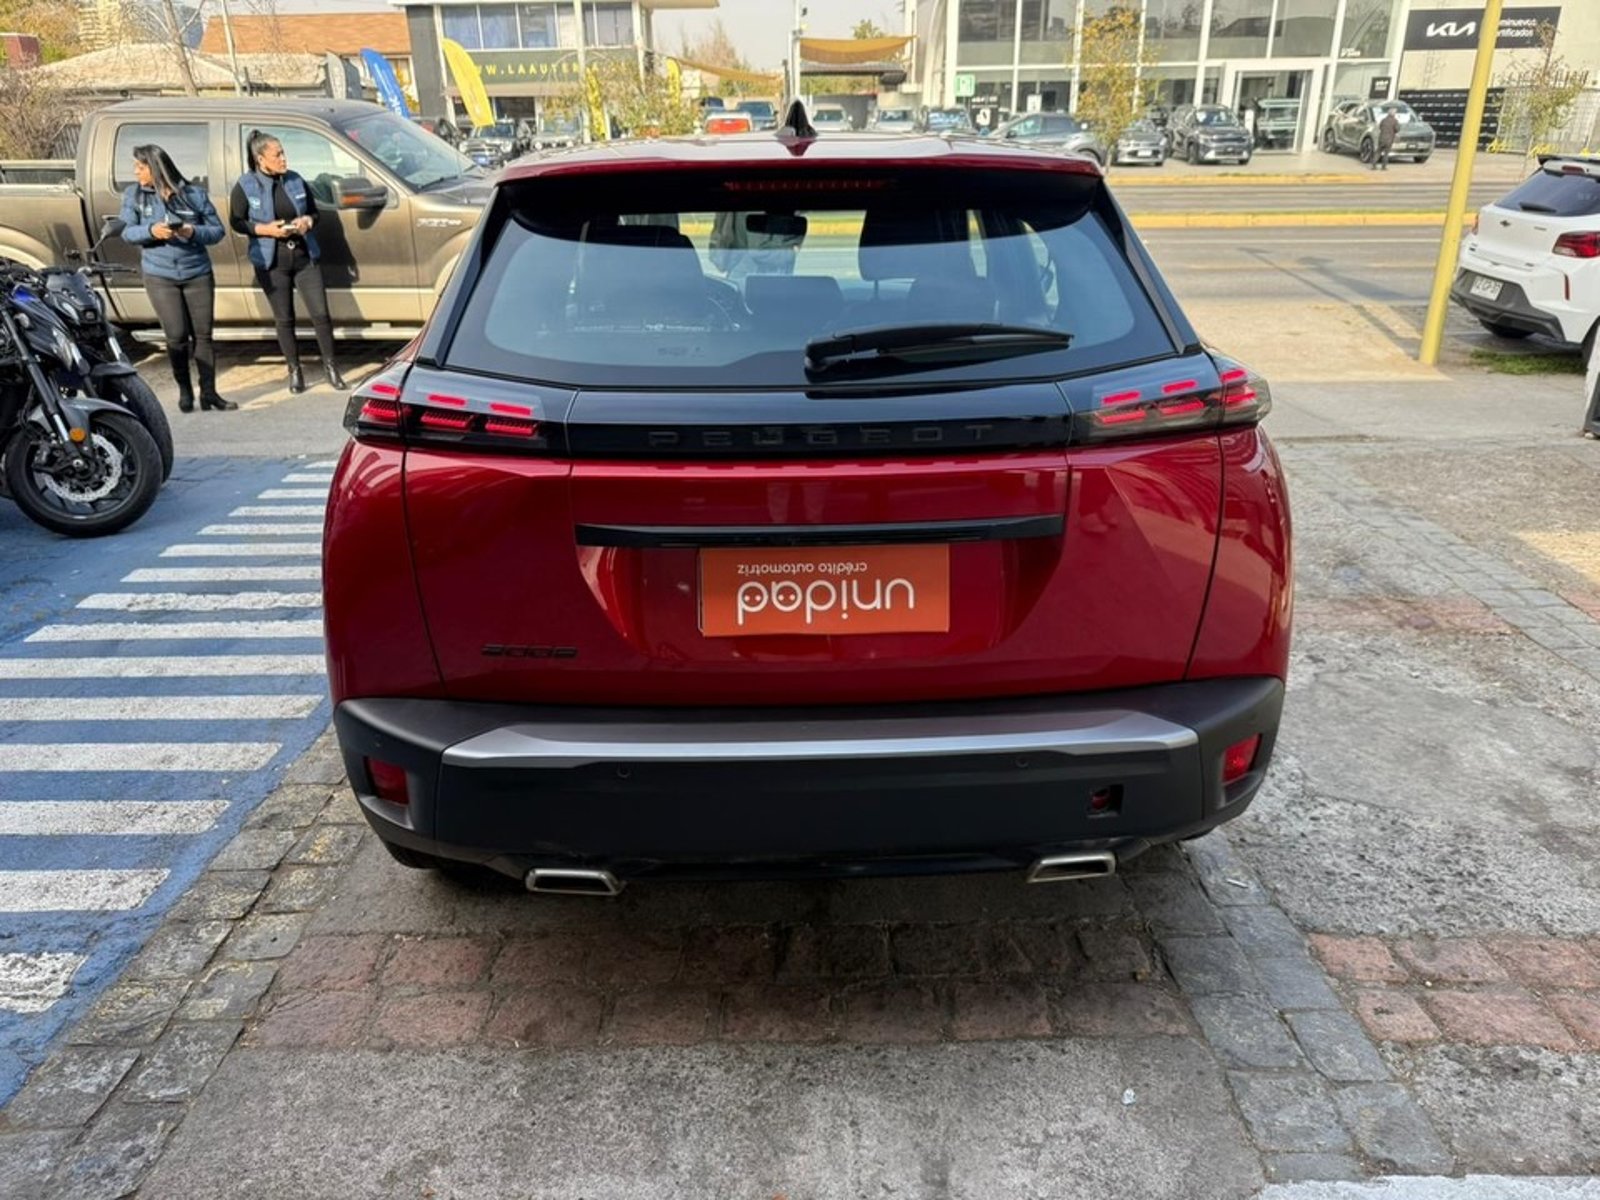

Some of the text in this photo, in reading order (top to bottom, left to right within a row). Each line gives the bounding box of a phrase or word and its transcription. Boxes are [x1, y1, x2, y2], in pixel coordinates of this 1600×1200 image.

[648, 424, 993, 447] PEUGEOT
[737, 562, 868, 577] crédito automotriz
[737, 577, 915, 626] unidad
